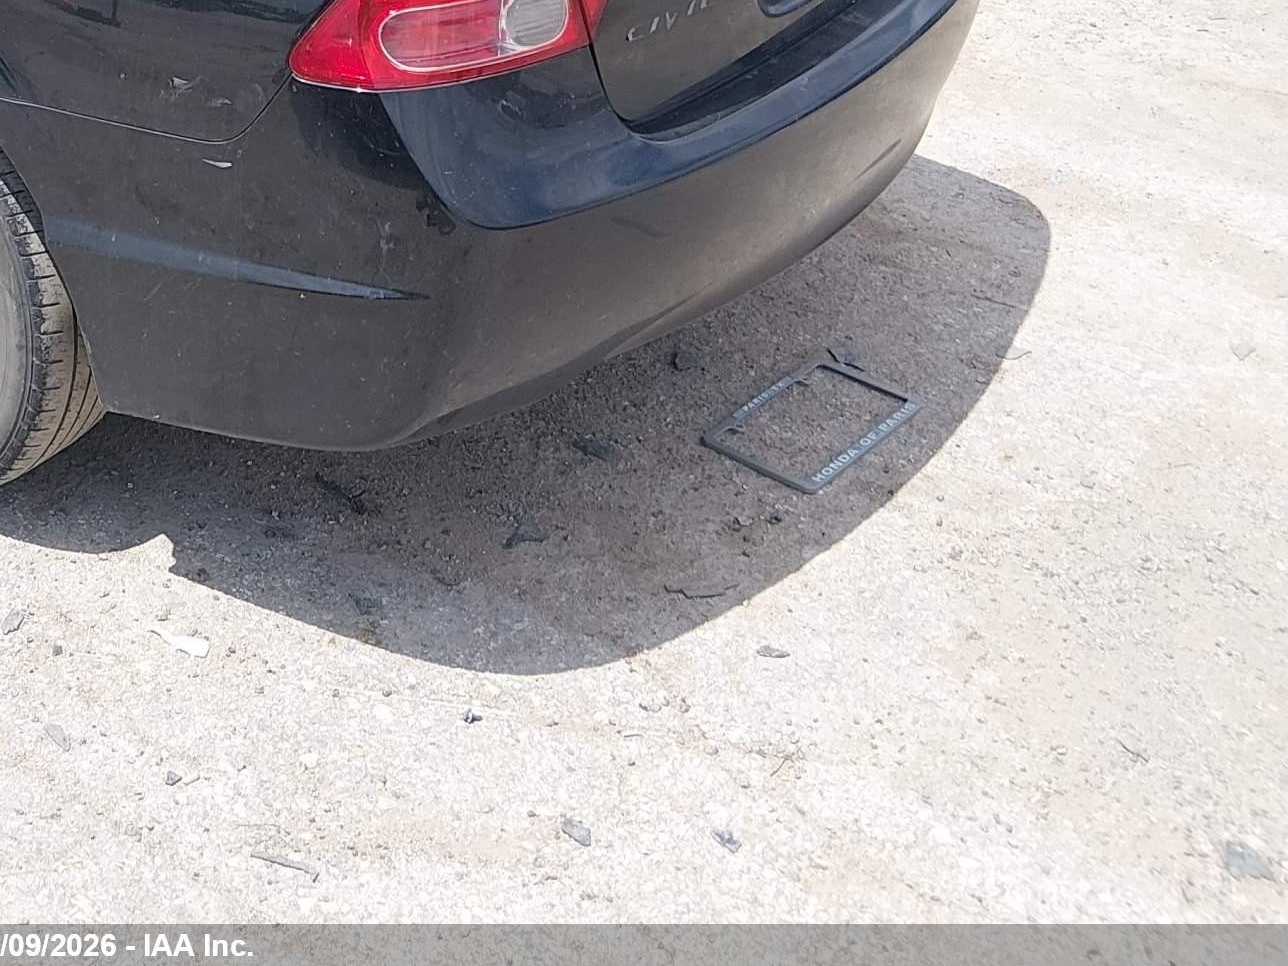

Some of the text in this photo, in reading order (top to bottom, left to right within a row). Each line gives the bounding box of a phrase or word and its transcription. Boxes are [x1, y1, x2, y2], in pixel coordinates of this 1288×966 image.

[812, 402, 916, 482] HONDA OF PARIS
